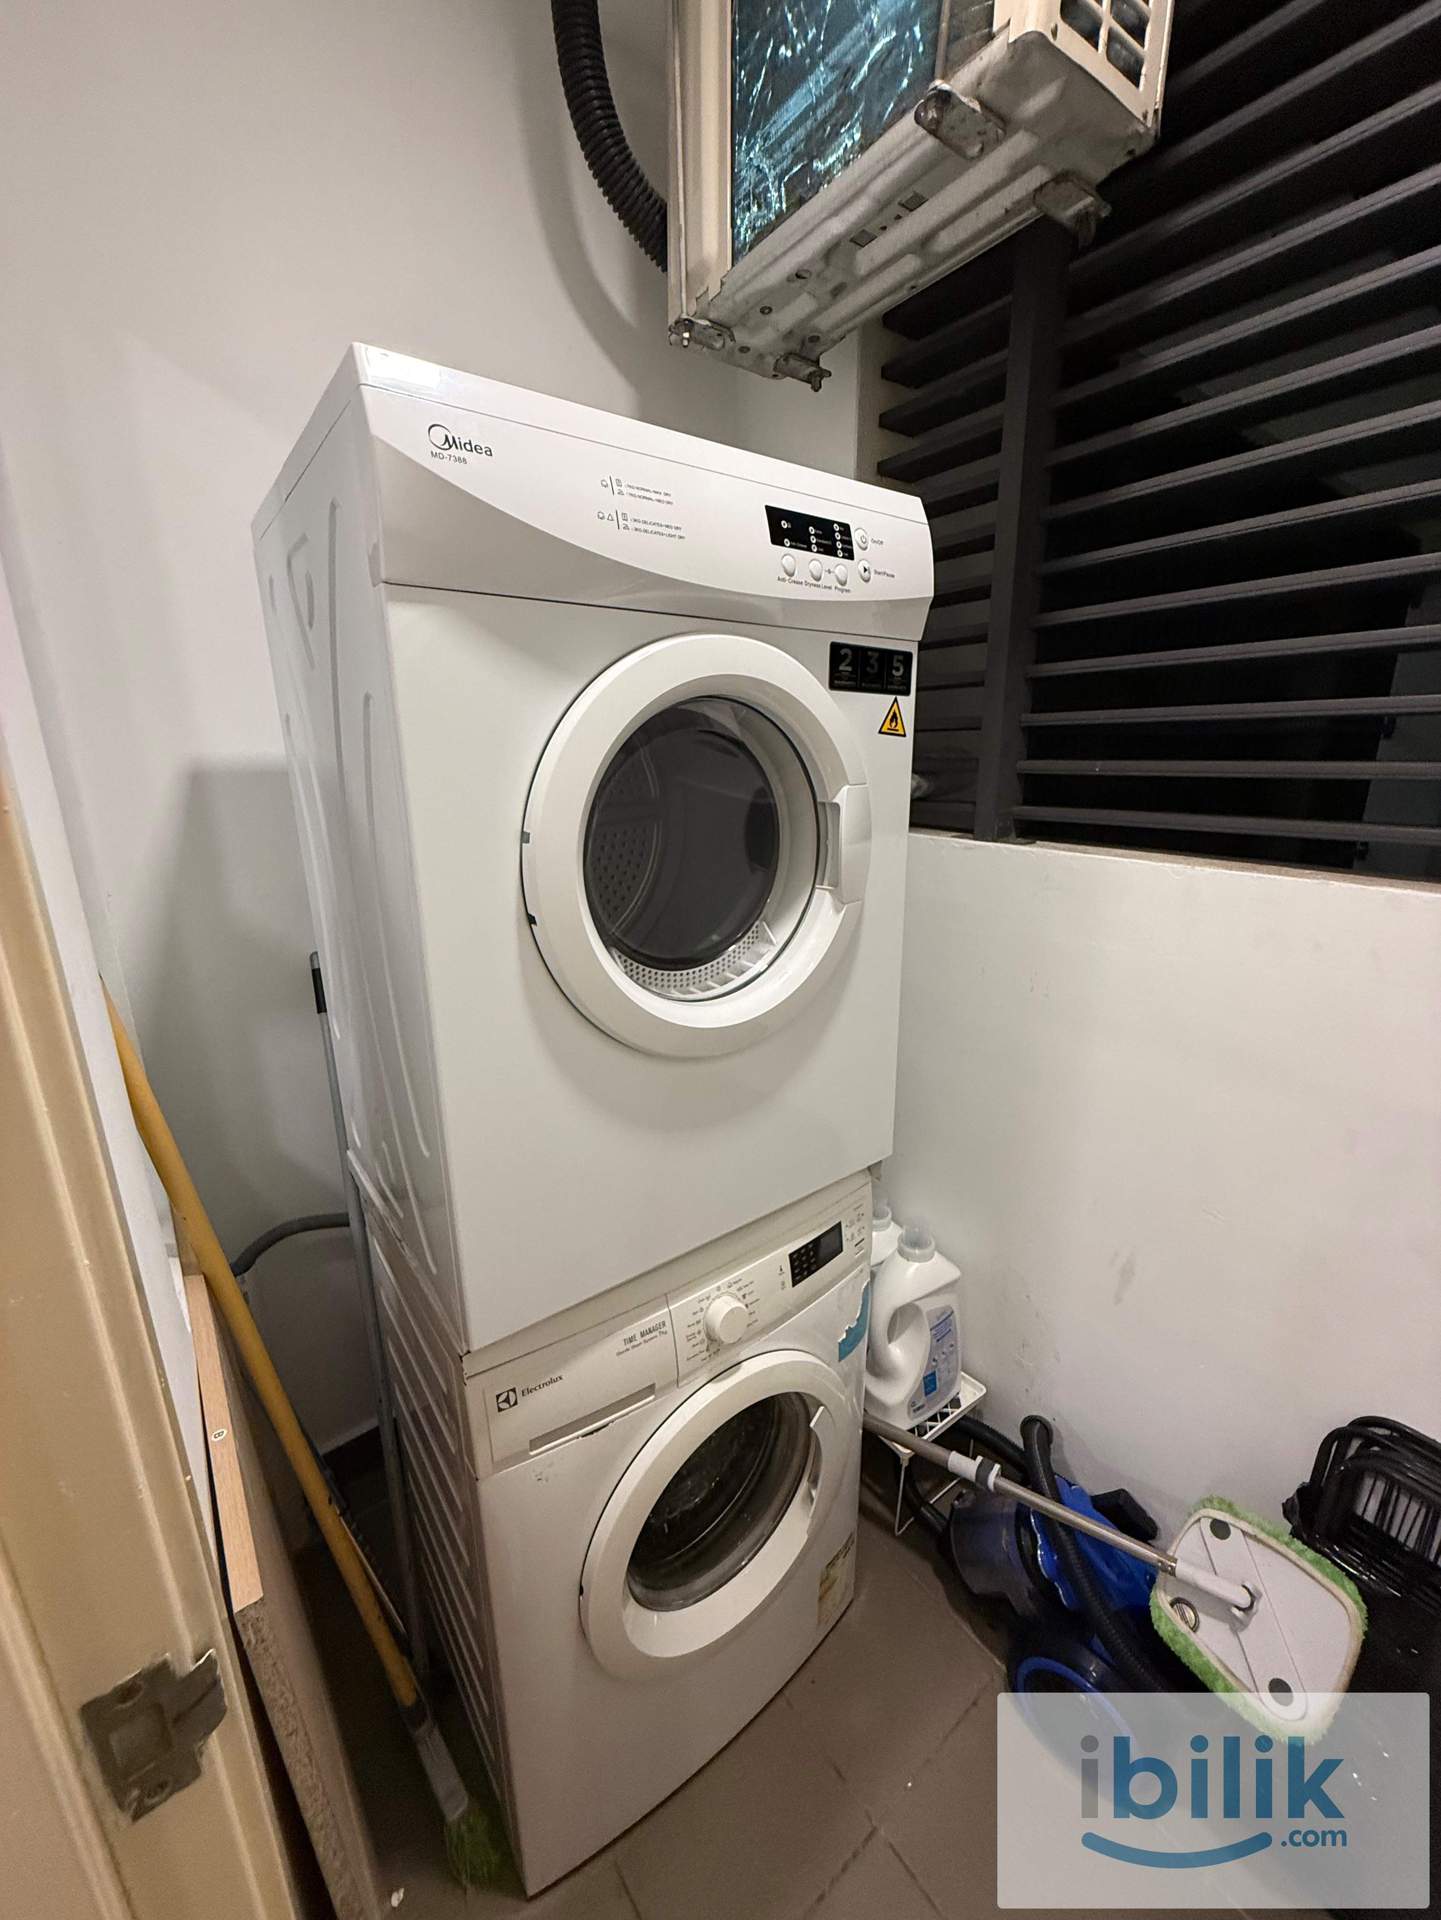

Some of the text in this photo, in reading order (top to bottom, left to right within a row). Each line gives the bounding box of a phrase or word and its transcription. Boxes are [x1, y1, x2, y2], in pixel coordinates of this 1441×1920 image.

[428, 424, 493, 457] Midea
[838, 647, 904, 677] 2 3 5
[623, 1320, 666, 1346] TIME MANAGER
[521, 1375, 564, 1397] Electrolux
